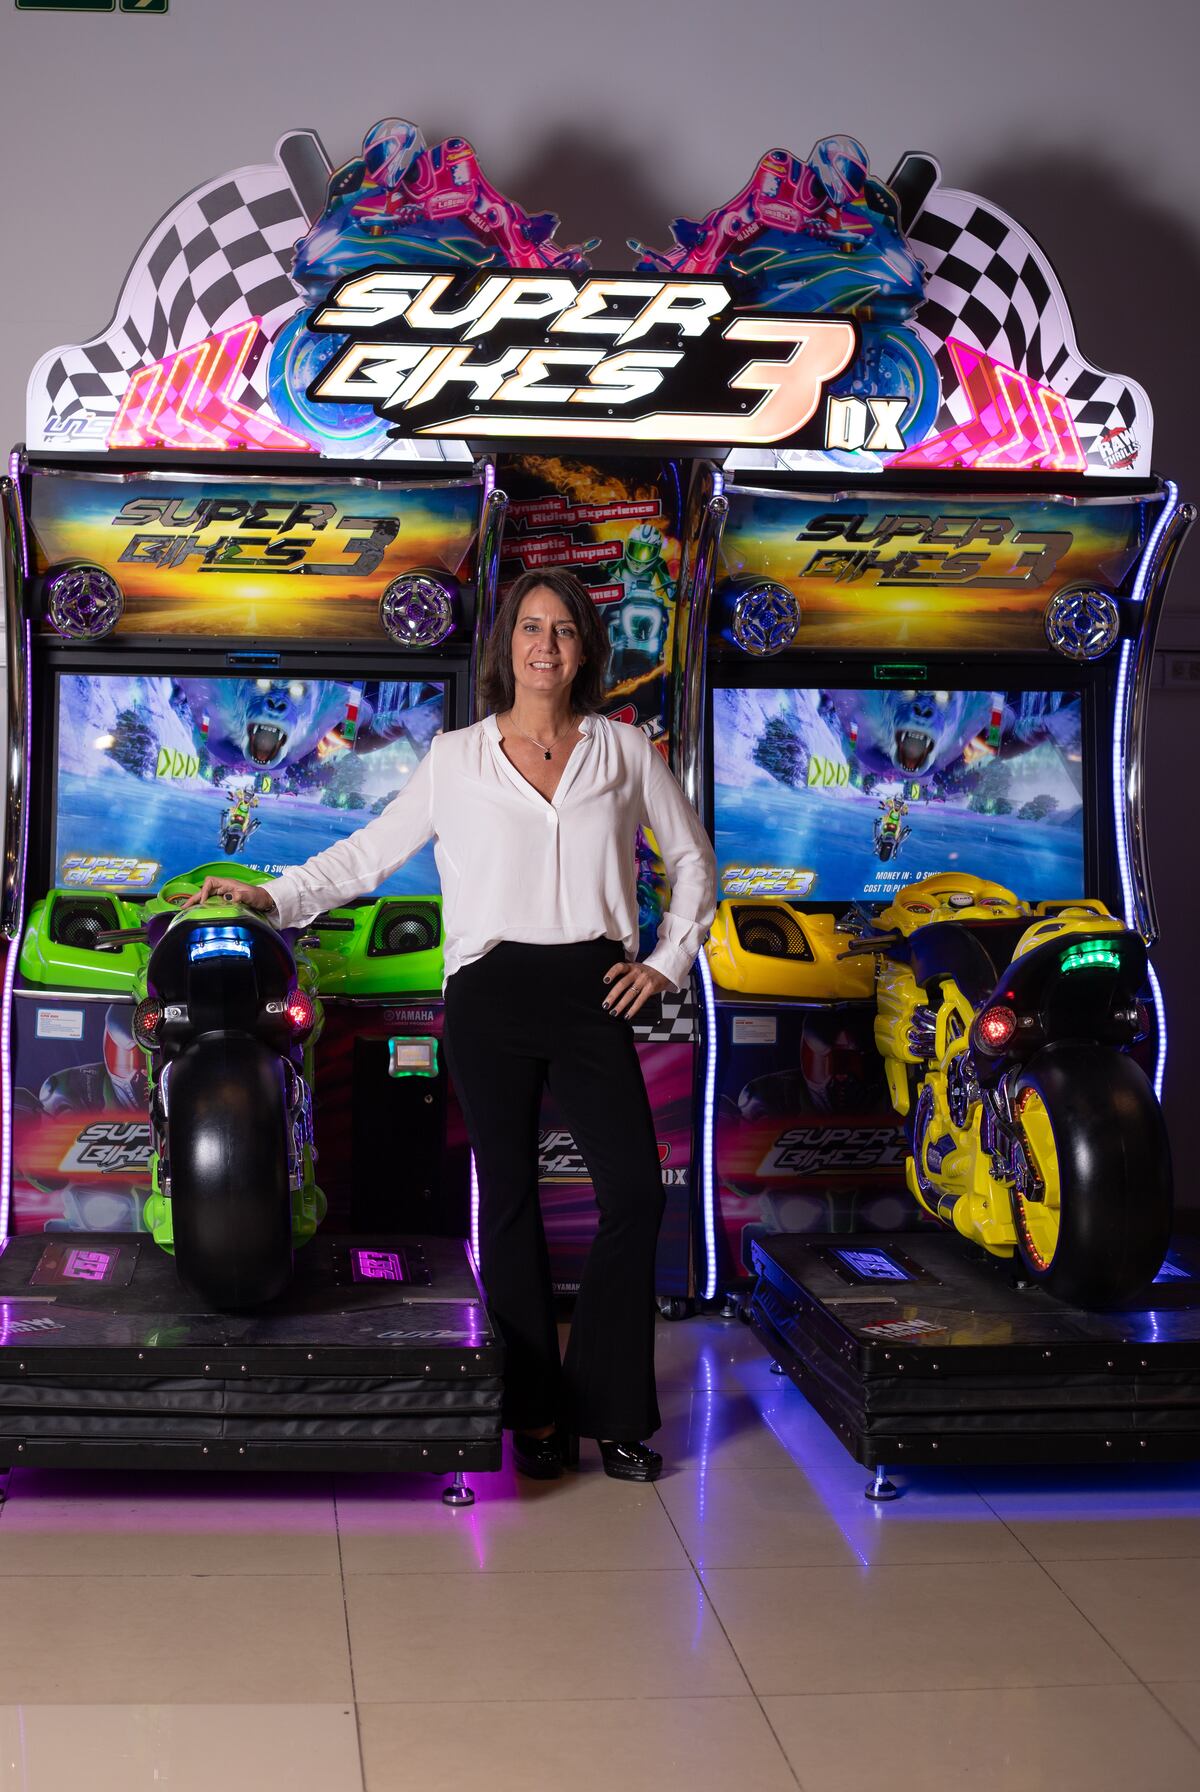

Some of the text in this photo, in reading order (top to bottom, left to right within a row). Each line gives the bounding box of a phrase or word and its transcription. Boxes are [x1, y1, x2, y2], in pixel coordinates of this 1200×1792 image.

[314, 273, 732, 346] SUPER
[314, 343, 685, 409] BIKES
[825, 396, 911, 451] DX
[1100, 427, 1135, 458] RAW
[1104, 440, 1142, 467] THRILLS
[111, 497, 337, 534] SUPER
[532, 504, 654, 523] Riding Experience
[796, 513, 1015, 549] SUPER
[117, 515, 400, 577] BIKES 3
[502, 539, 566, 554] Fantastic
[528, 545, 617, 564] Visual Impact
[798, 530, 1074, 589] BIKES 3
[63, 857, 139, 869] SUPER
[65, 863, 159, 887] BIKES 3
[722, 868, 795, 880] SUPER
[723, 872, 815, 896] BIKES 3
[876, 871, 901, 880] MONEY
[863, 884, 881, 893] COST
[883, 884, 892, 893] TO
[395, 1010, 434, 1021] YAMAHA
[78, 1124, 150, 1143] SUP
[777, 1128, 896, 1147] SUPER
[79, 1144, 154, 1165] BIKE
[775, 1148, 876, 1168] BIKES
